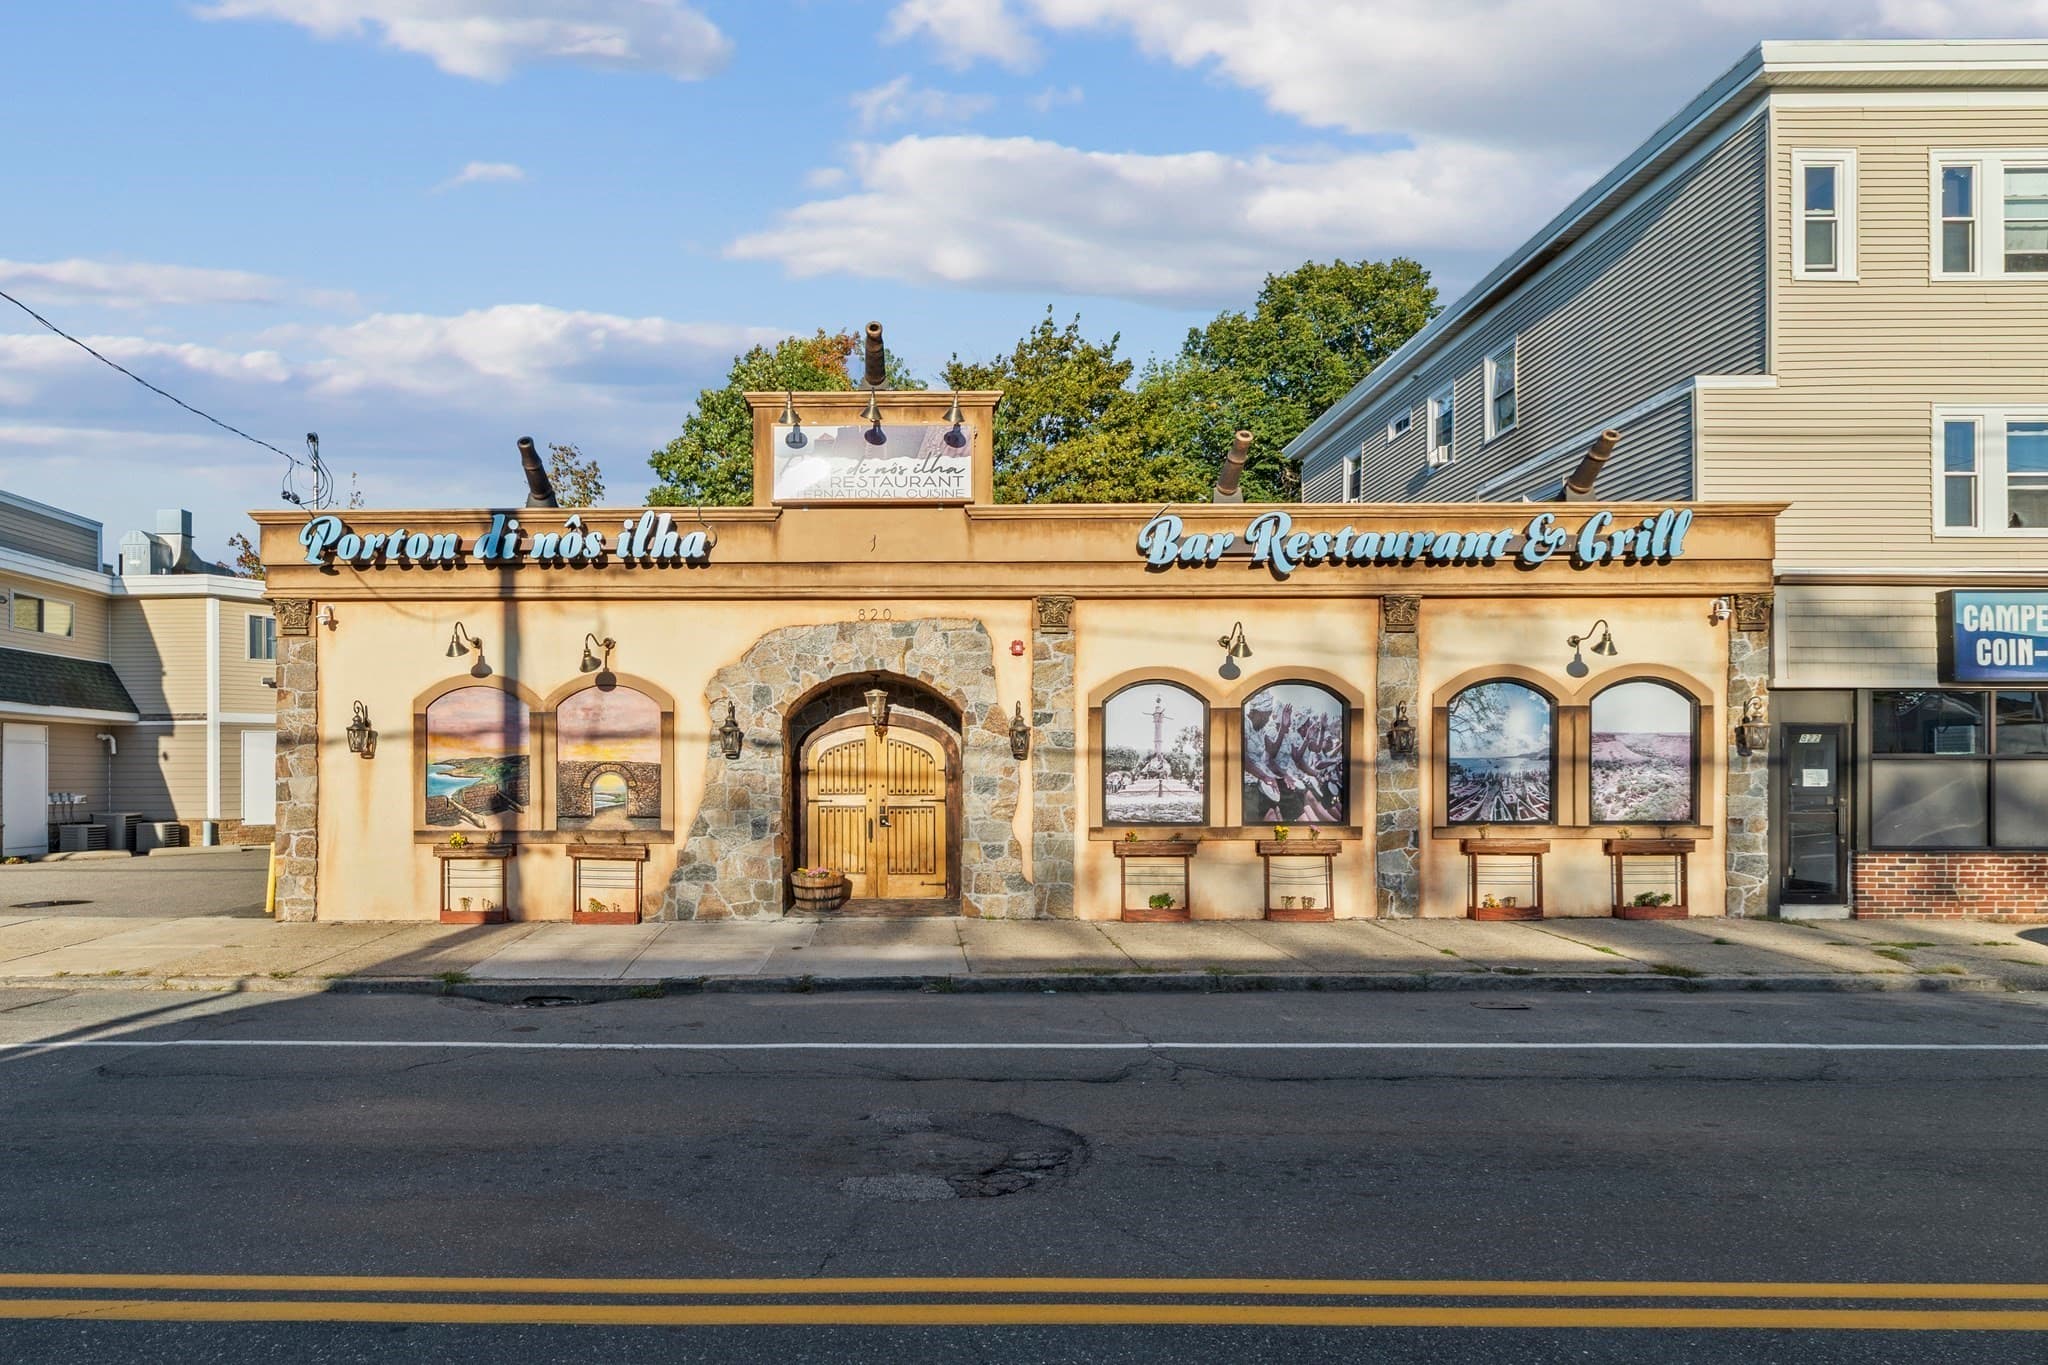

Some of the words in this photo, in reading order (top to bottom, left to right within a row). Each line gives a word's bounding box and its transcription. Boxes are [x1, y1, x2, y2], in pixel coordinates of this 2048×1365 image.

[846, 455, 870, 475] di
[912, 451, 966, 474] ilha
[830, 475, 964, 488] RESTAURANT
[803, 489, 896, 498] ERNATIONAL
[905, 489, 965, 498] CUISINE
[299, 515, 458, 565] Porton
[473, 513, 519, 559] di
[530, 514, 603, 559] nôs
[616, 510, 708, 559] ilha
[1138, 514, 1235, 565] Bar
[1245, 511, 1514, 574] Restaurant
[1521, 513, 1566, 563] &
[1578, 508, 1694, 562] Grill
[858, 608, 892, 621] 820
